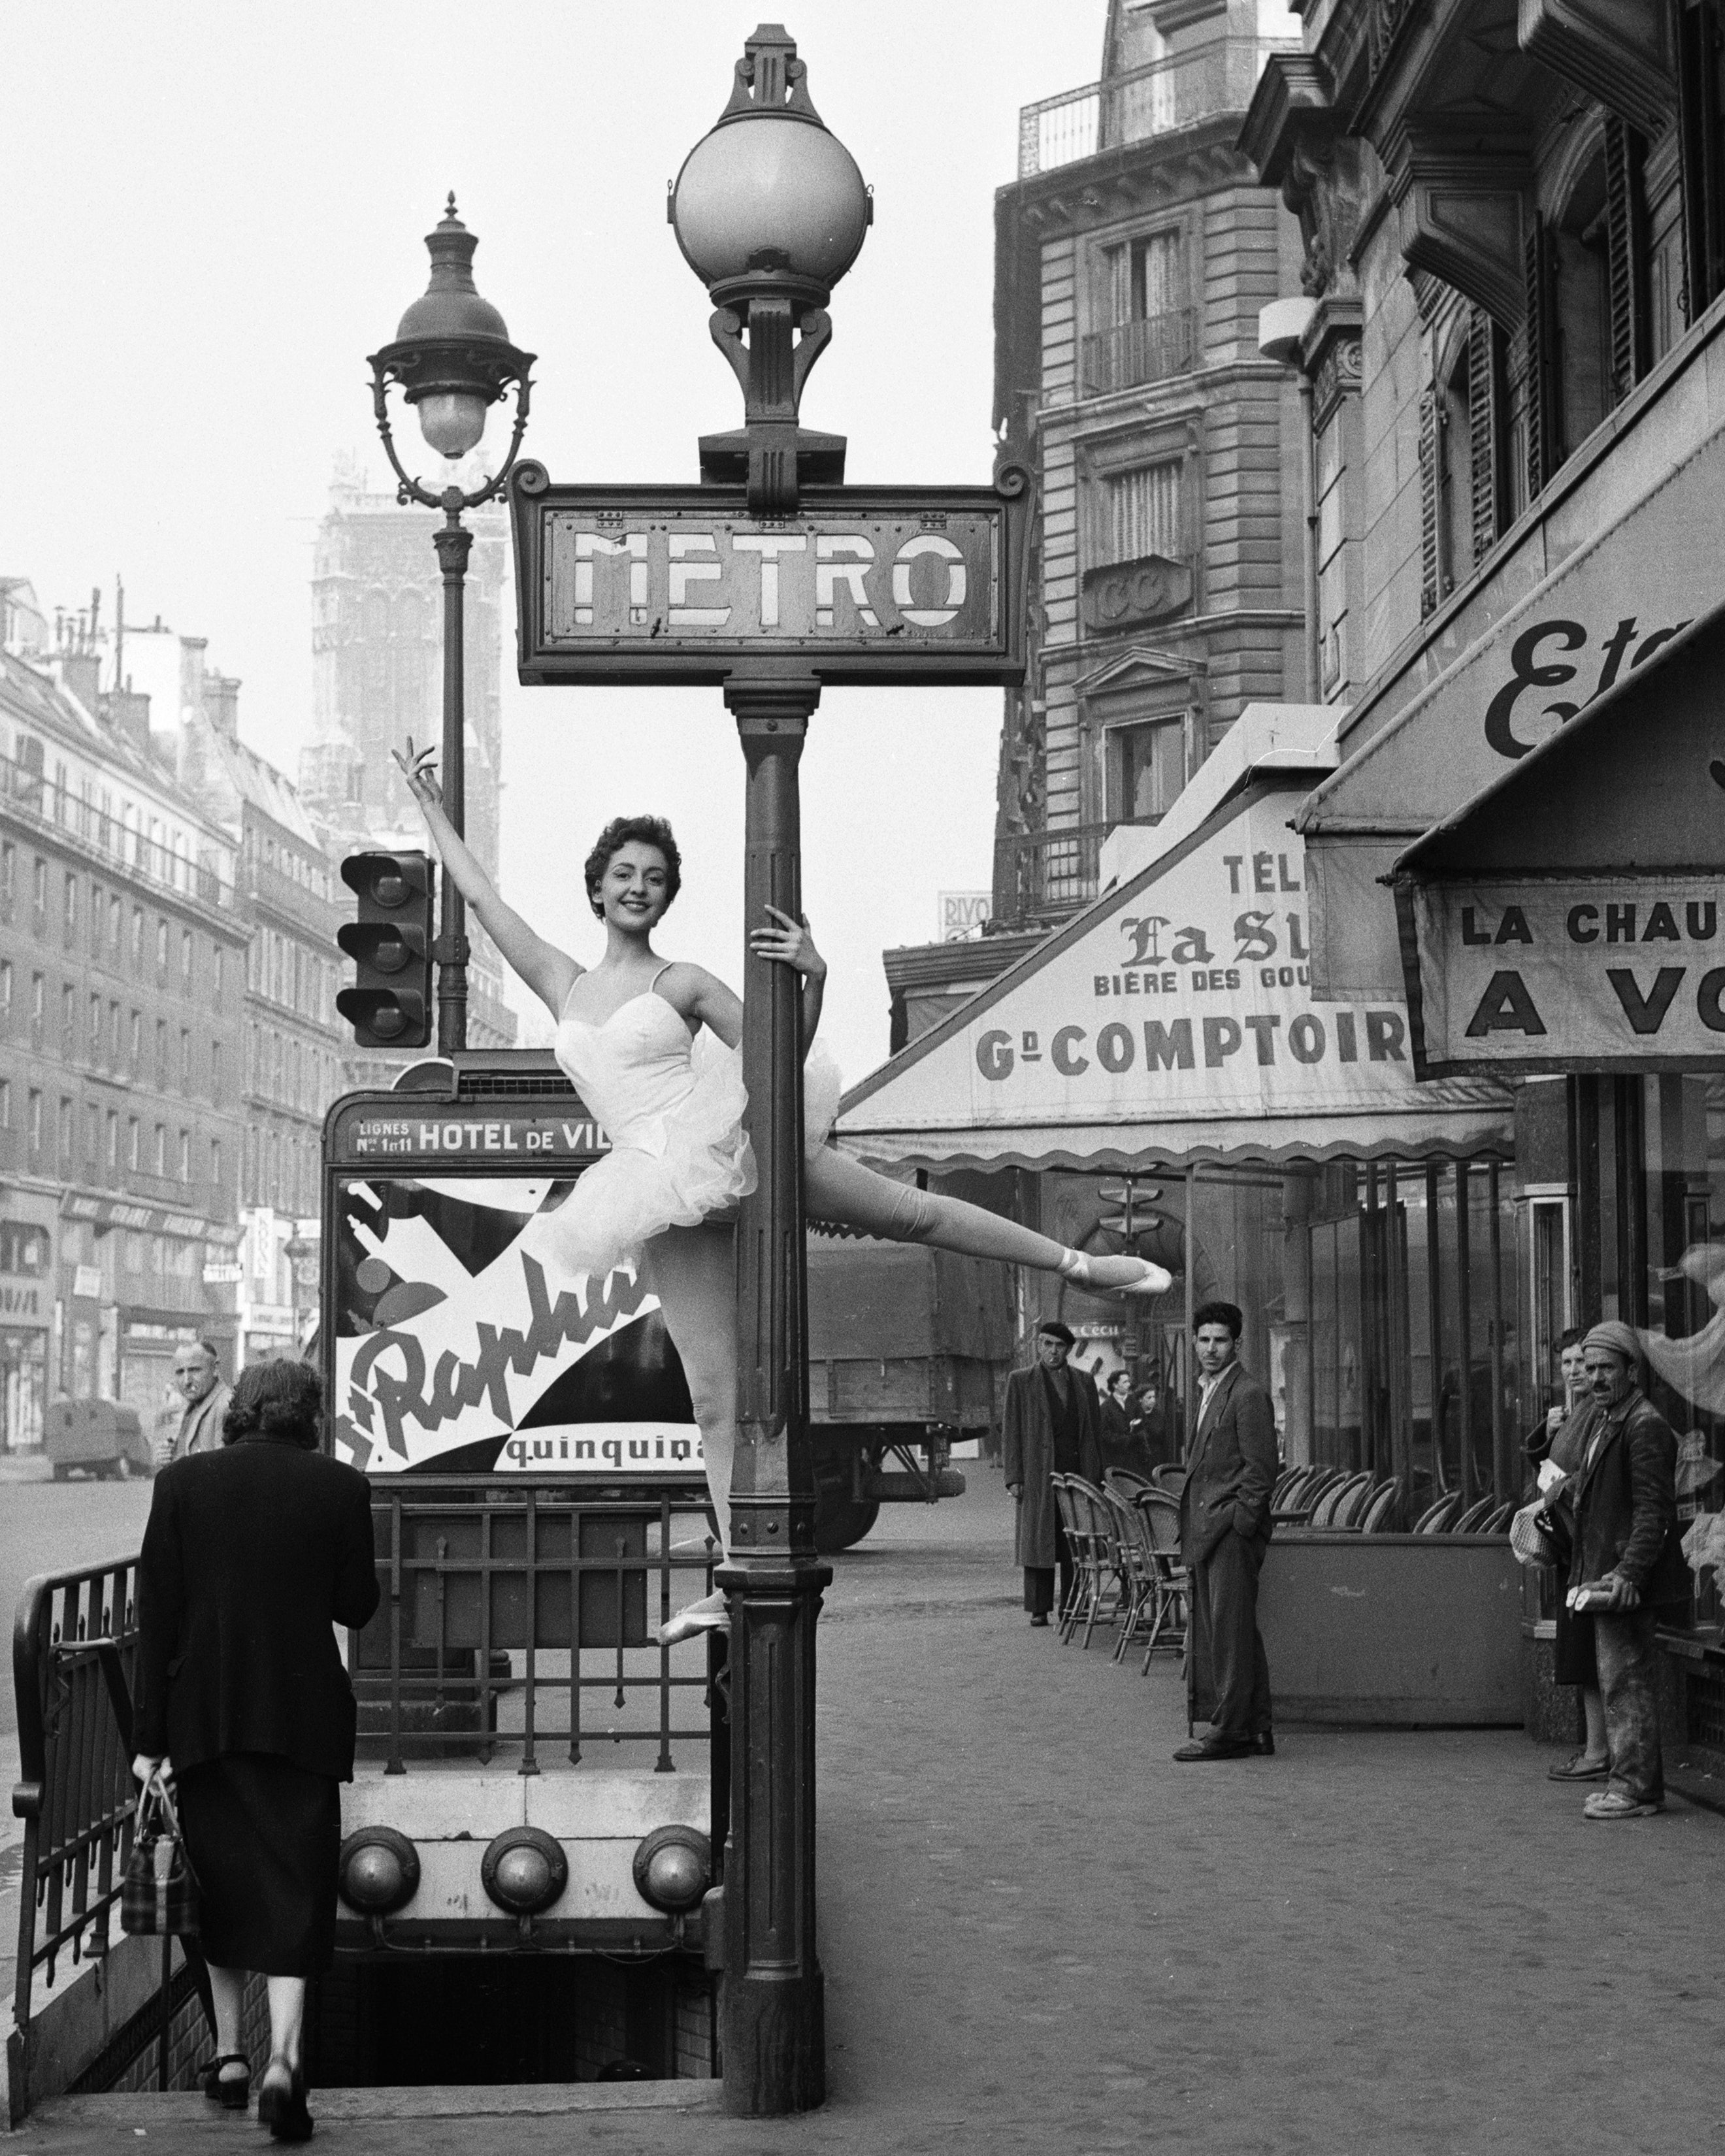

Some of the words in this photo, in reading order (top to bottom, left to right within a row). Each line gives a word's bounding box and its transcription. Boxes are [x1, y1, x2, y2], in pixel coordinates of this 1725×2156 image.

[574, 532, 967, 627] METRO
[1462, 906, 1534, 945] LA
[1567, 902, 1717, 943] CHAU
[1192, 969, 1240, 992] DES
[1051, 1011, 1407, 1076] COMPTOIR
[360, 1123, 410, 1135] LIGNES
[419, 1124, 518, 1150] HOTEL
[527, 1132, 553, 1149] DE
